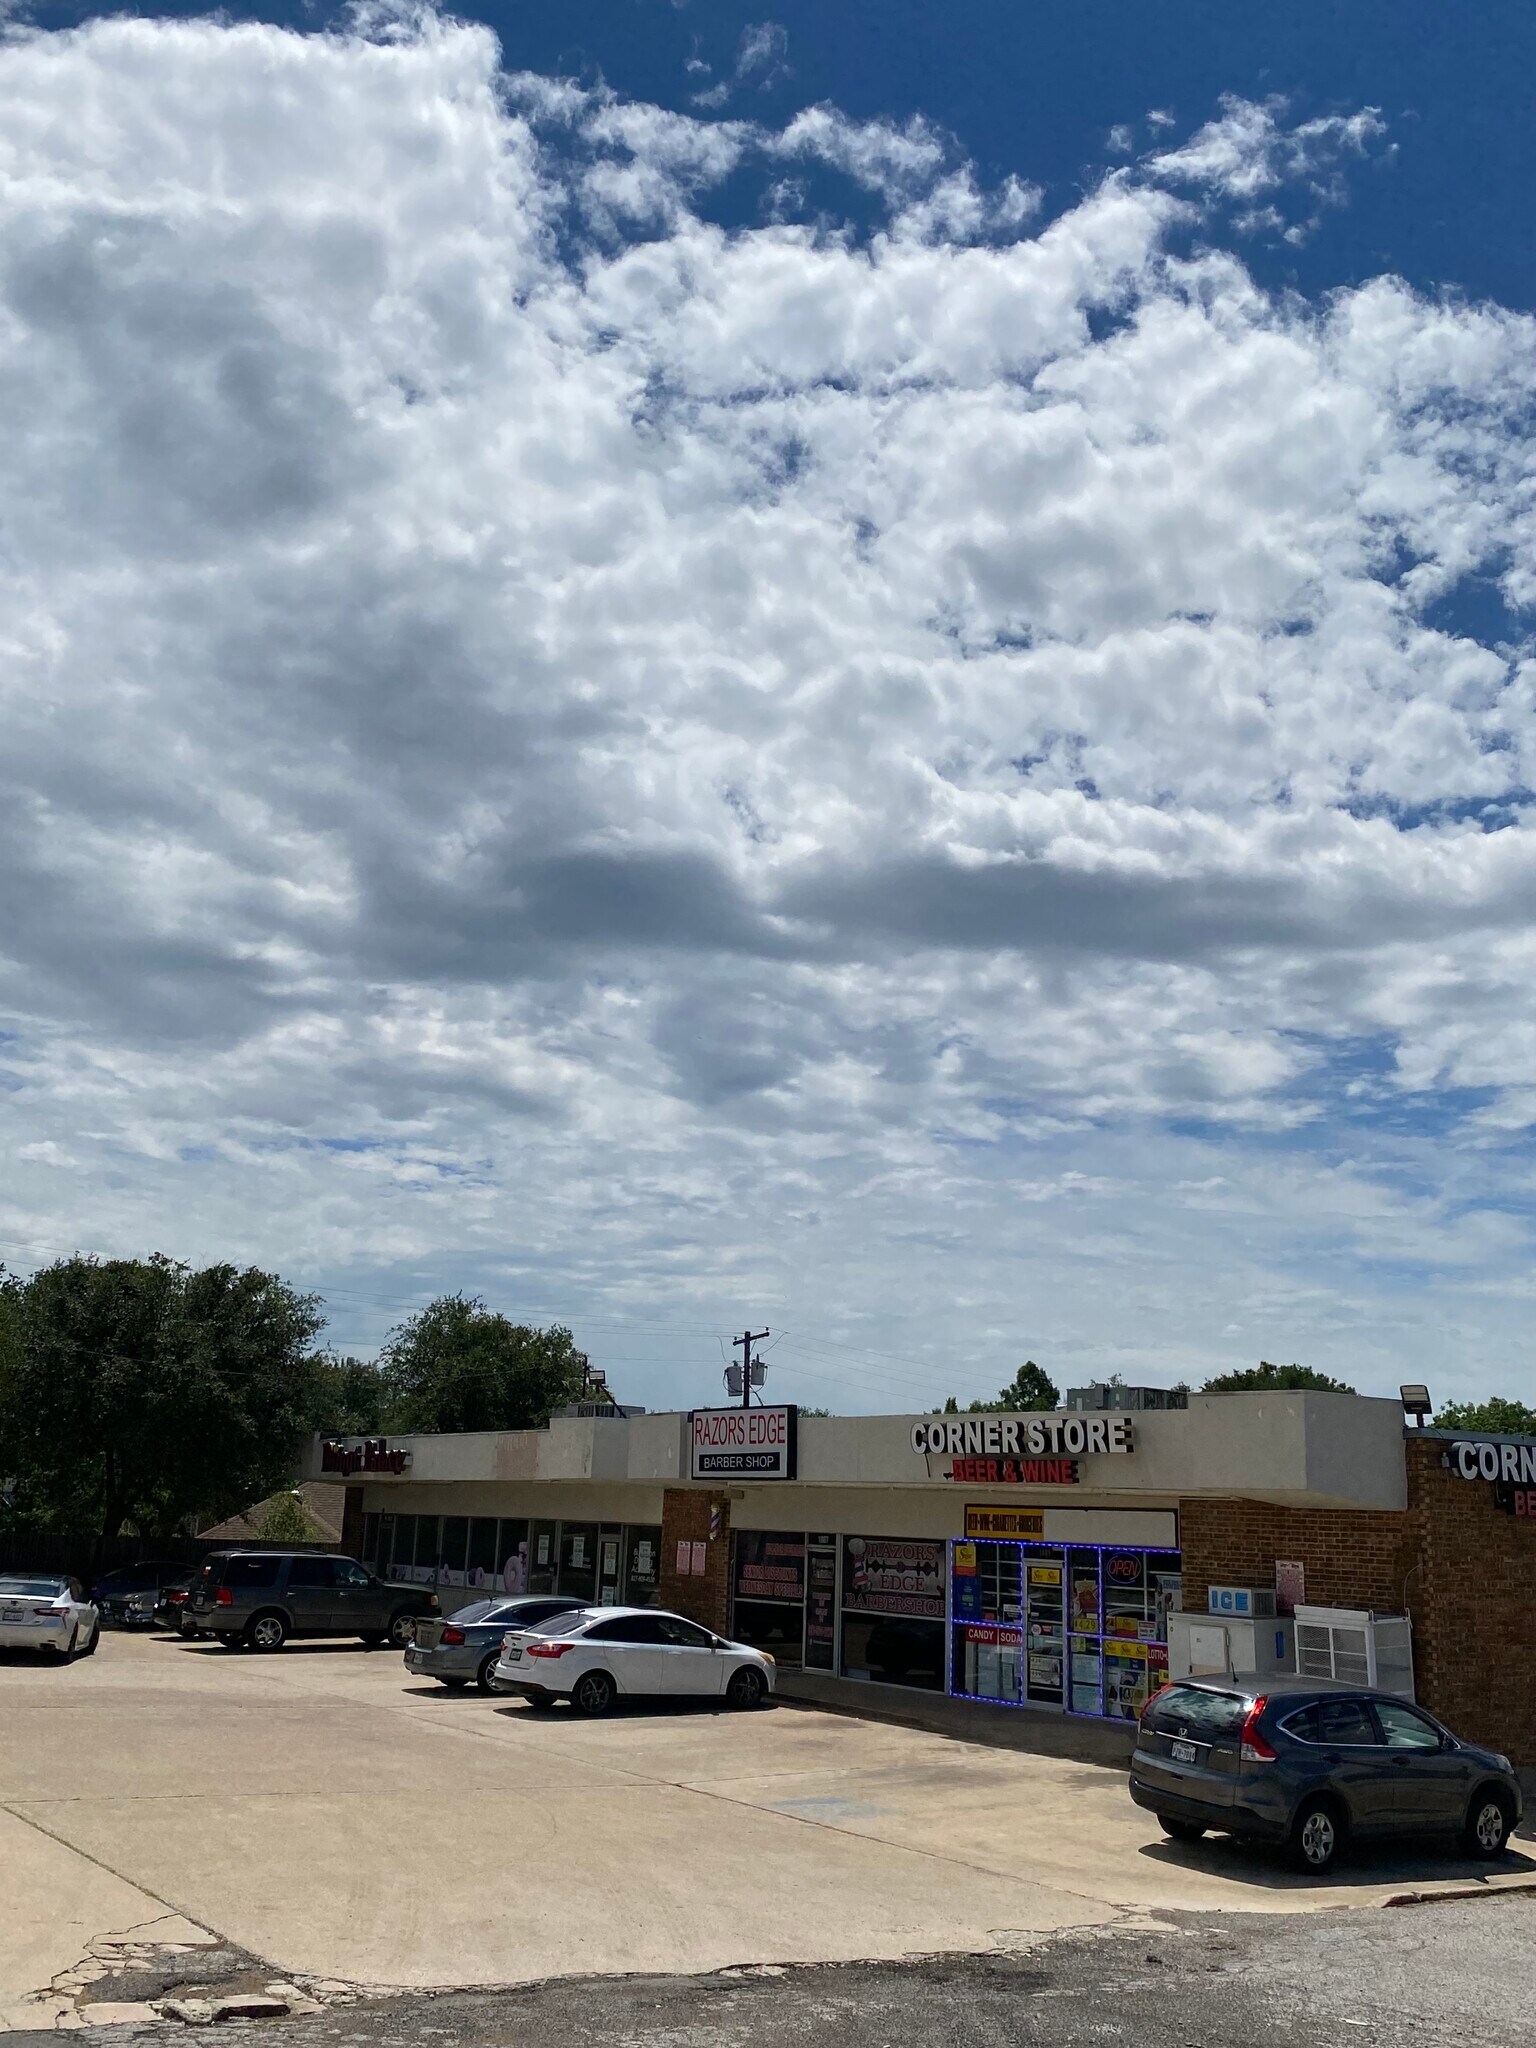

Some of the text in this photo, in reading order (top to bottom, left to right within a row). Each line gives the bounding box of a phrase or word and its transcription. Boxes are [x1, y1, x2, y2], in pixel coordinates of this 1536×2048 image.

[694, 1414, 786, 1446] RAZORS EDGE
[911, 1418, 1130, 1454] CORNER STORE
[703, 1455, 774, 1469] BARBER SHOP
[953, 1459, 1074, 1484] BEER & WINE
[1457, 1441, 1536, 1483] CORN
[869, 1543, 936, 1561] RAZORS
[1108, 1560, 1138, 1577] OPEN
[879, 1574, 925, 1592] EDGE
[844, 1592, 946, 1617] BARBERSHOP
[1211, 1590, 1249, 1611] ICE
[968, 1628, 1022, 1644] CANDY SODA
